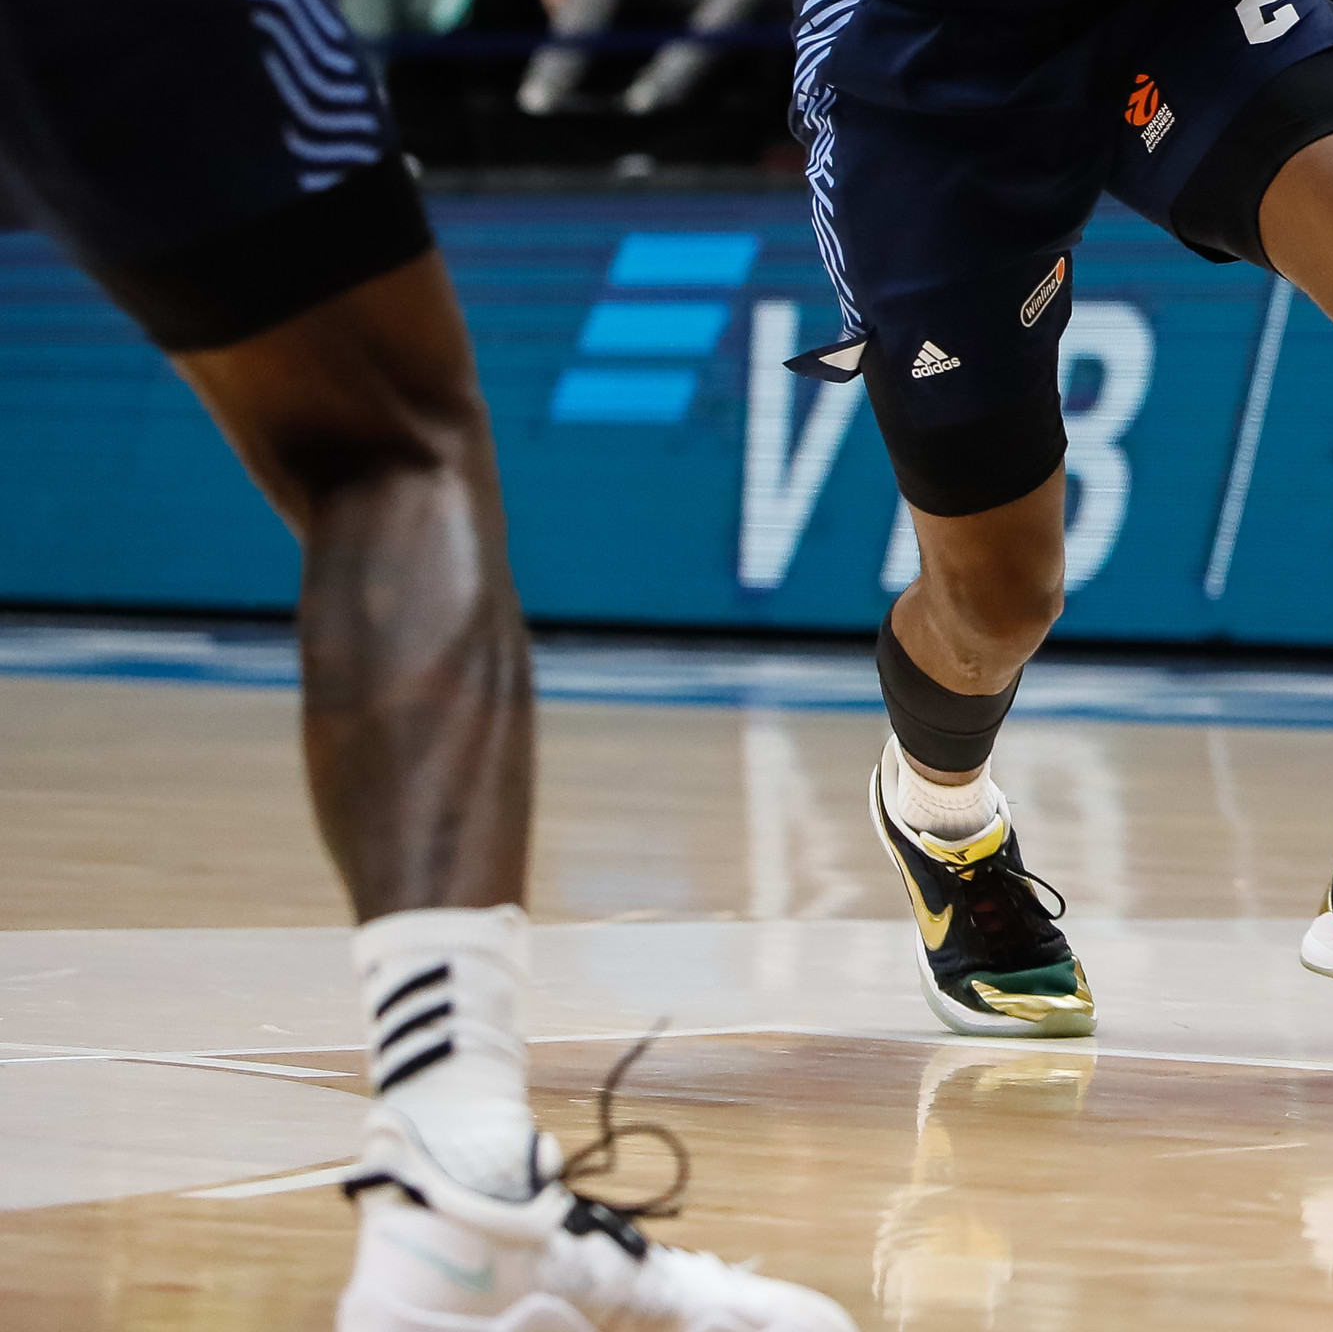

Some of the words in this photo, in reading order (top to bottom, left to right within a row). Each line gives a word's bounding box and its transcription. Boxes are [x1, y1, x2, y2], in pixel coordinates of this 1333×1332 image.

[1140, 103, 1169, 140] TURKISH
[1145, 110, 1173, 148] AIRLINES
[1025, 278, 1056, 319] Winline
[911, 357, 961, 379] adidas
[736, 298, 1156, 594] VB
